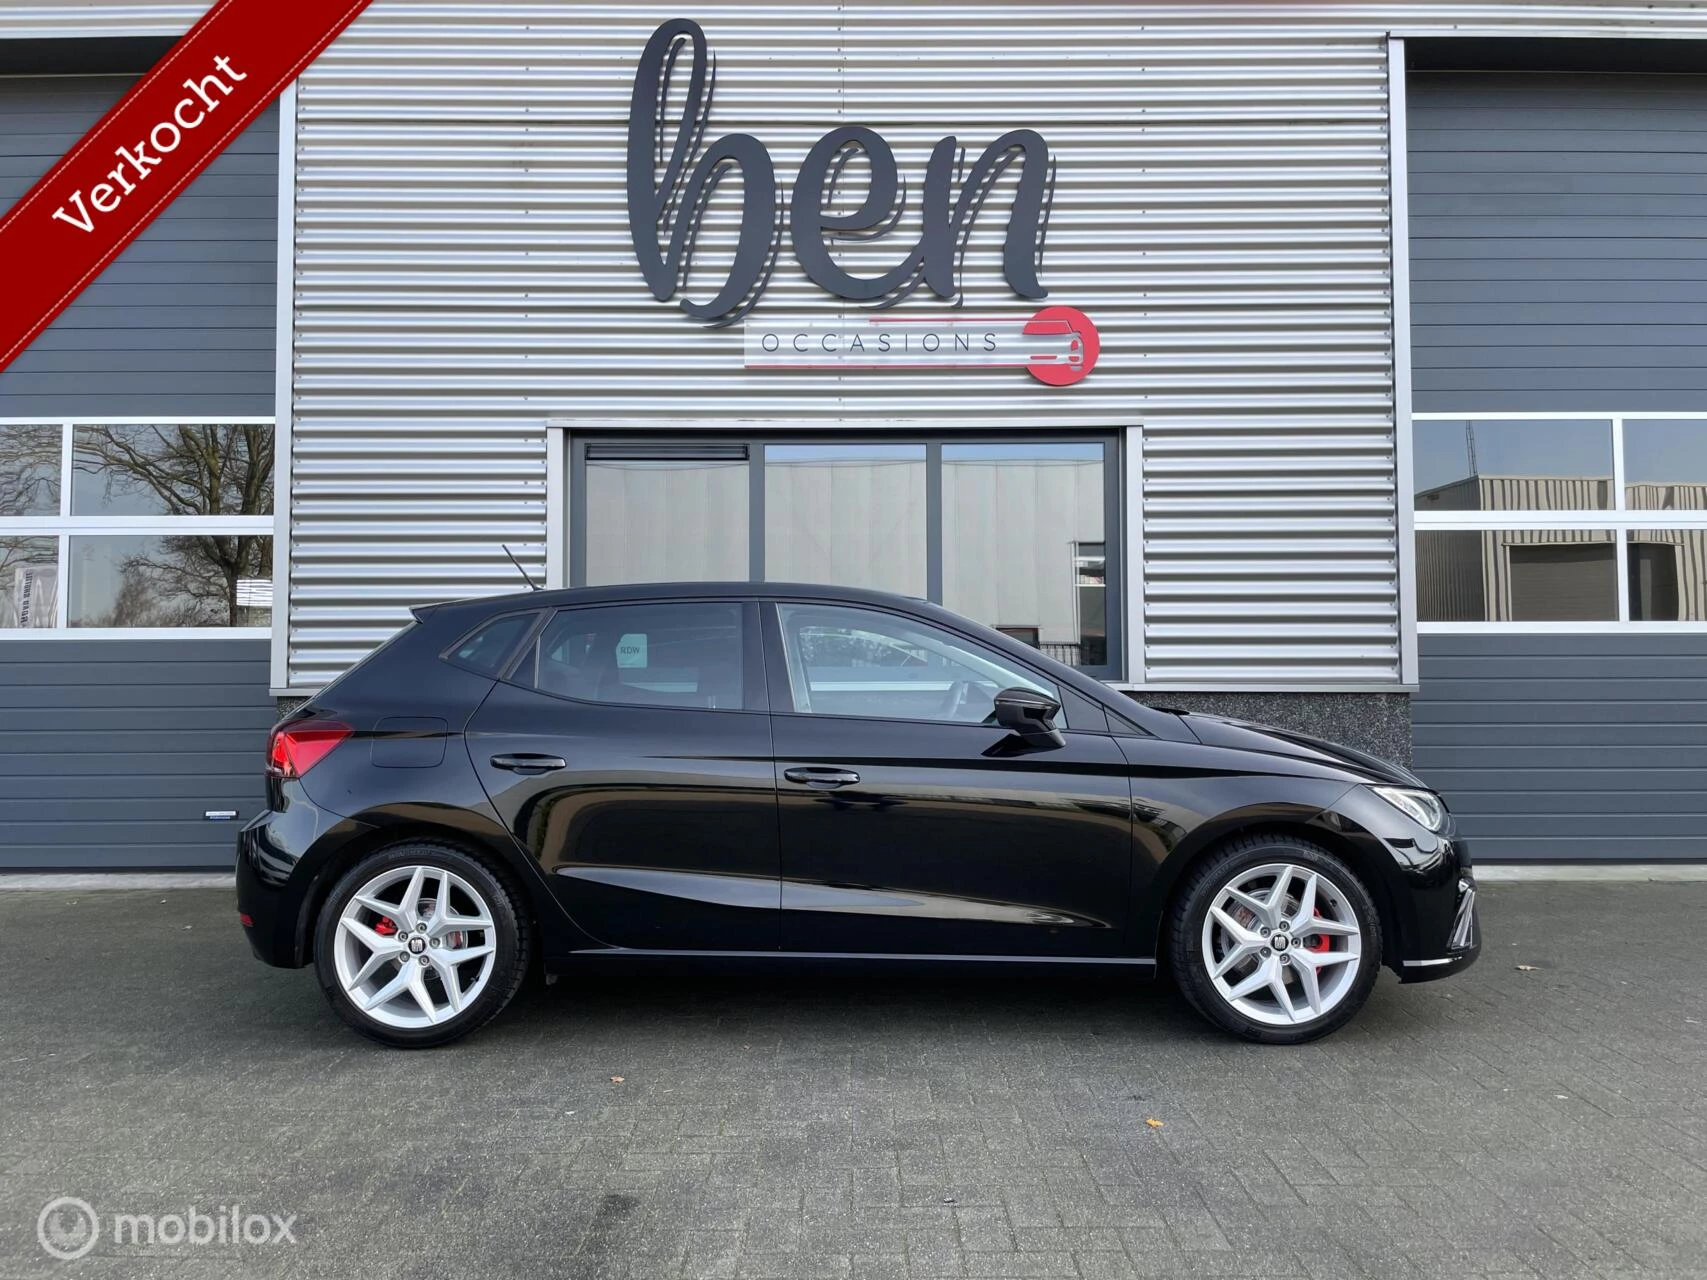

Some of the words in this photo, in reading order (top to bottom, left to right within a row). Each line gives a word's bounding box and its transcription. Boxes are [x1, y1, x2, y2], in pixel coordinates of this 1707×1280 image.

[627, 18, 1056, 327] ben
[761, 332, 997, 353] OCCASIONS
[620, 646, 640, 654] RDW
